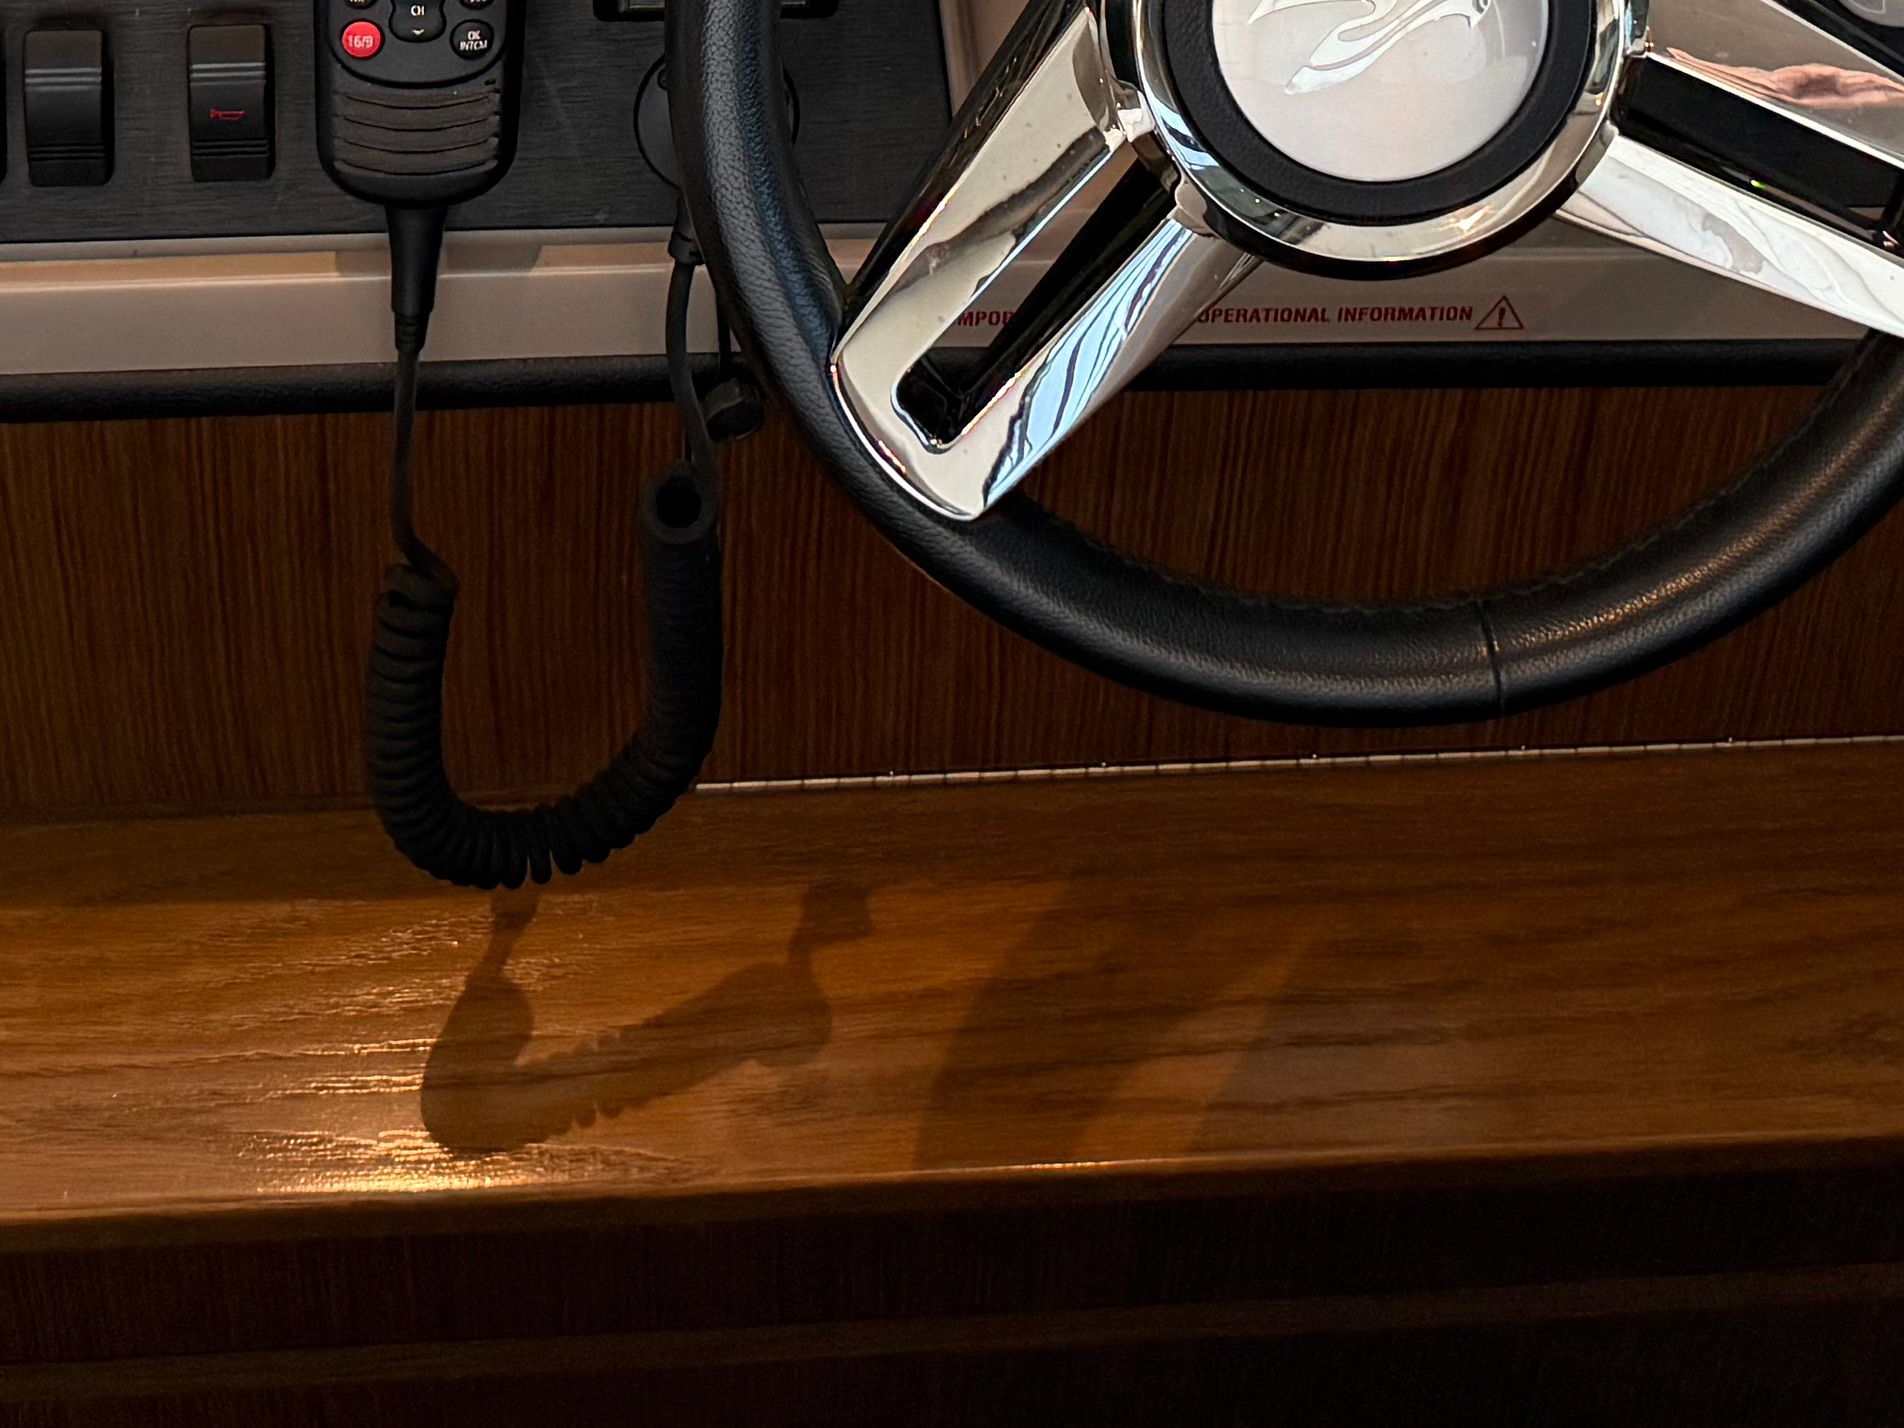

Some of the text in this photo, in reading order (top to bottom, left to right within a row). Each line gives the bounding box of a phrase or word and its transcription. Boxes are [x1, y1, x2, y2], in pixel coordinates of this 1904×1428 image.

[410, 5, 425, 16] CH
[348, 35, 373, 48] 16/9
[467, 30, 481, 41] OK
[1198, 308, 1330, 324] OPERATIONAL
[1337, 306, 1473, 322] INFORMATION
